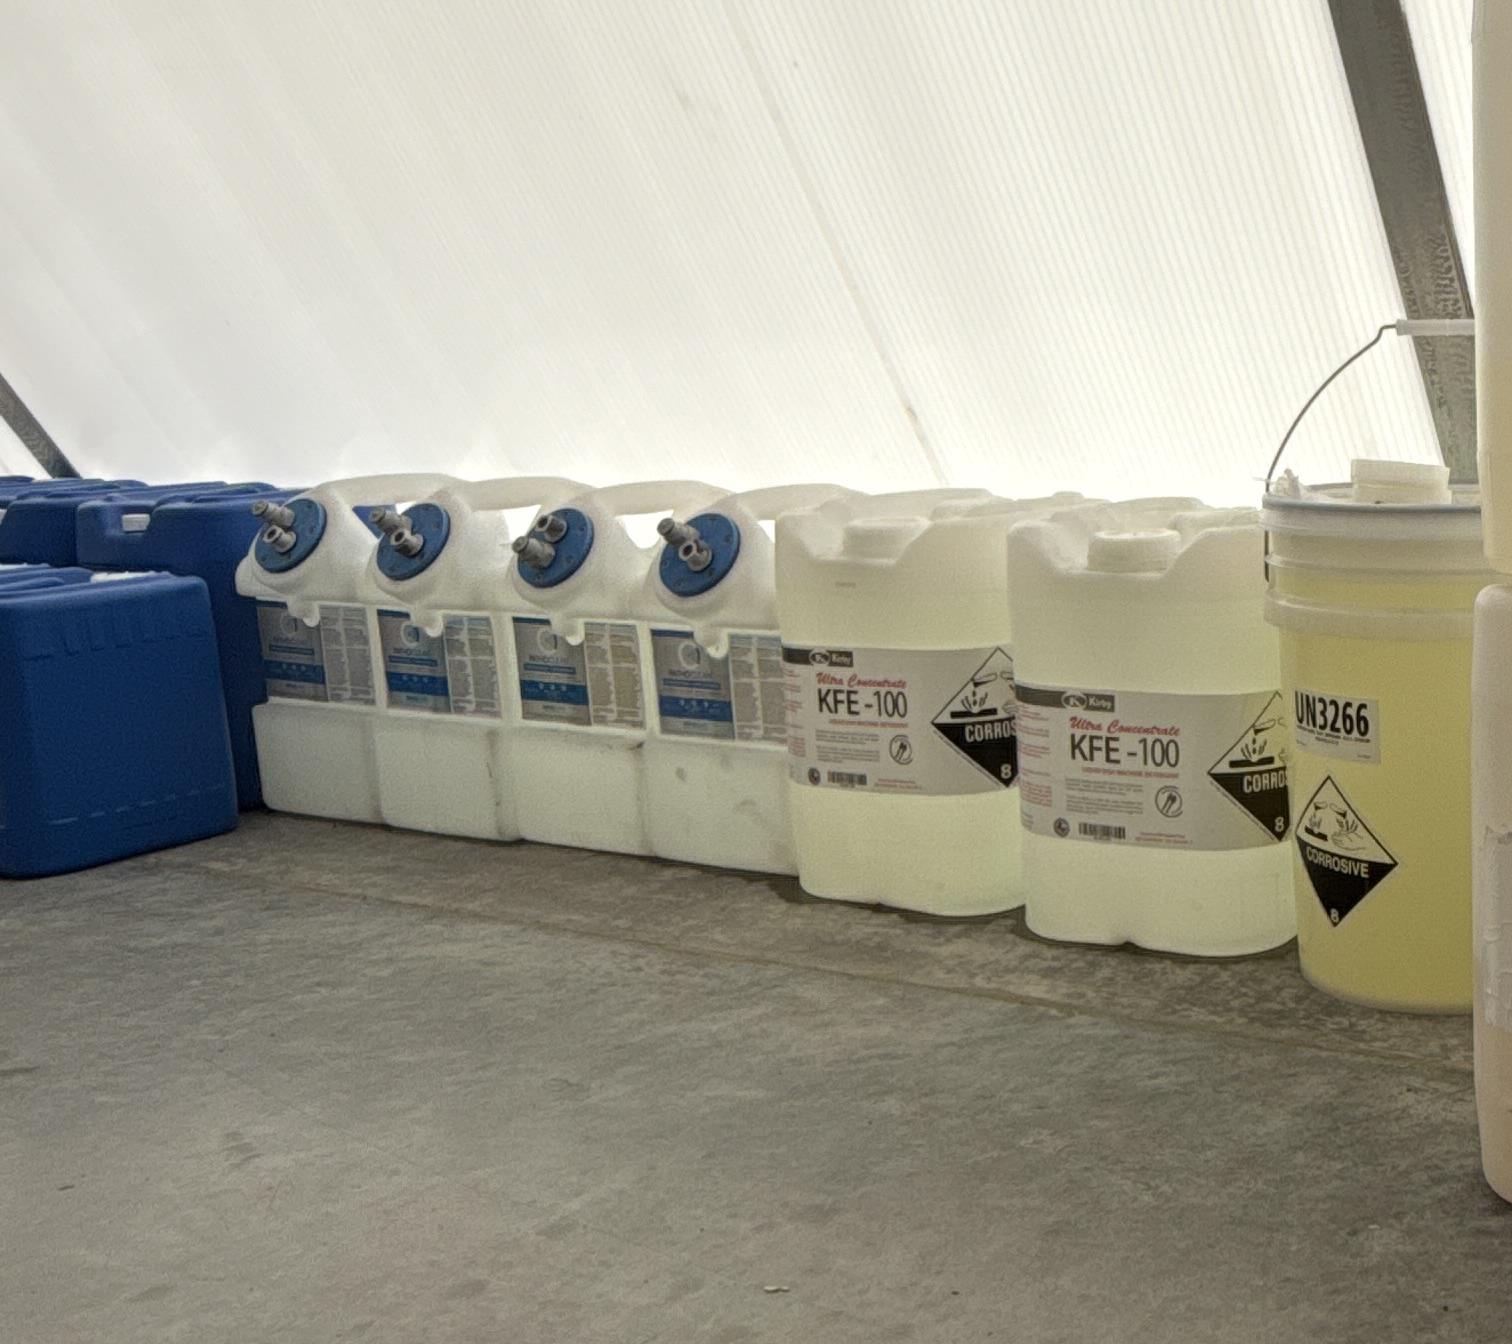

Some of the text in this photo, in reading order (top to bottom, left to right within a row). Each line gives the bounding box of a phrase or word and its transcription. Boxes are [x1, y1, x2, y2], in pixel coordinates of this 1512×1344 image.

[816, 672, 907, 689] Ultra Concentrate
[817, 688, 860, 716] KFE
[1294, 690, 1369, 737] UN3266
[1069, 716, 1180, 737] Ultra Concentrate
[1070, 733, 1120, 765] KFE
[1000, 763, 1012, 779] 8
[1275, 816, 1285, 833] 8
[1306, 846, 1370, 879] CORROSIVE
[1330, 908, 1340, 923] 8
